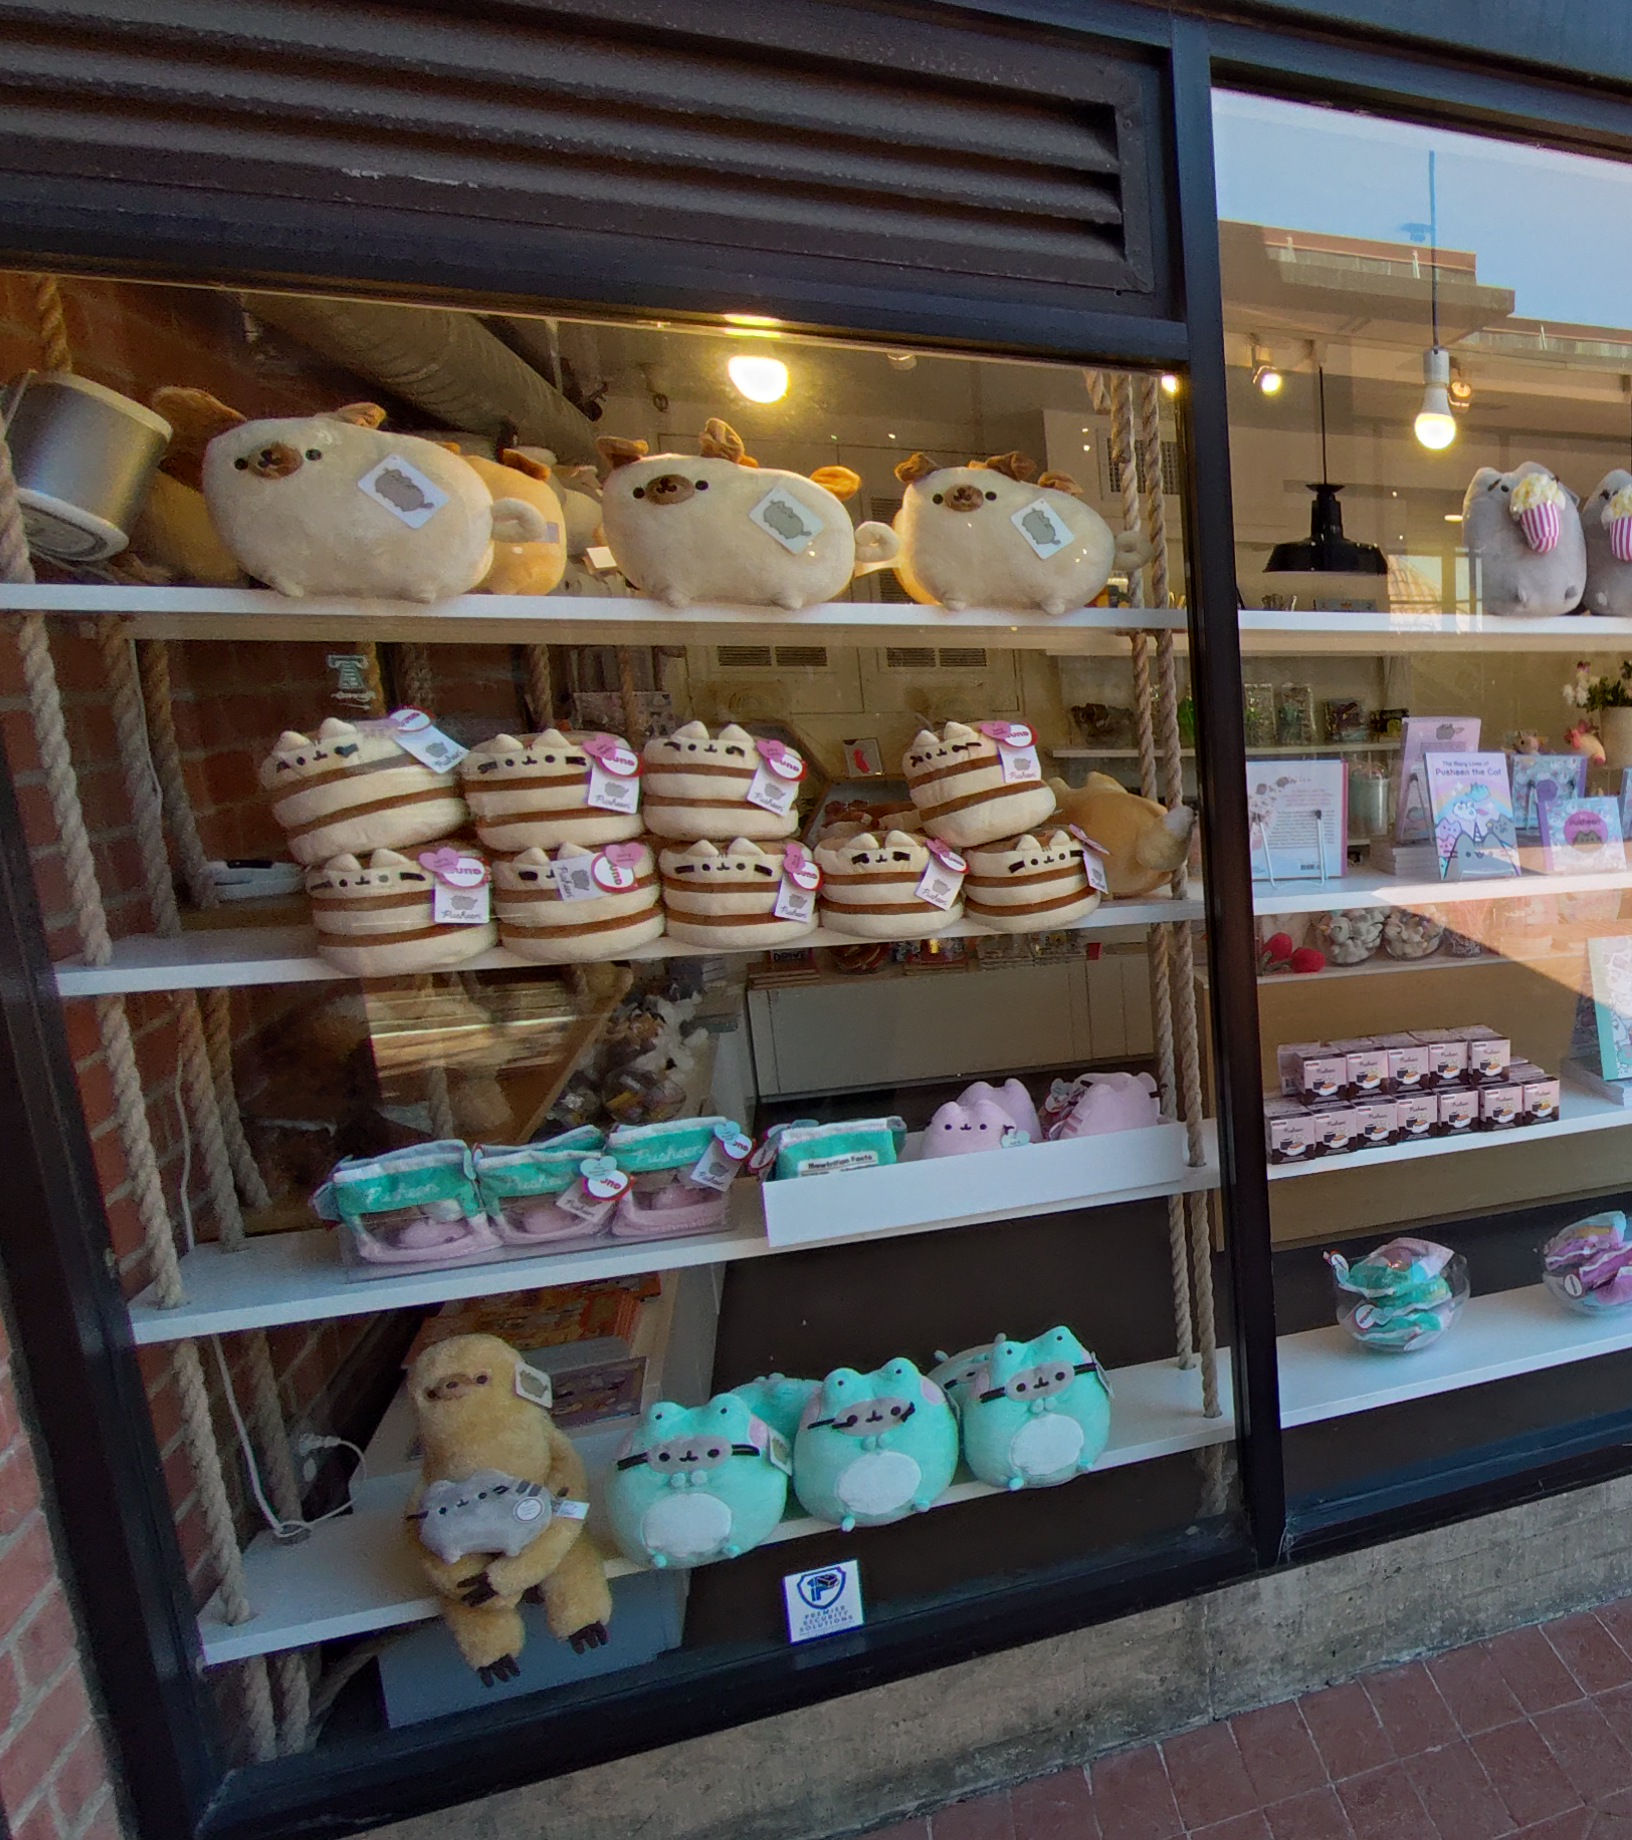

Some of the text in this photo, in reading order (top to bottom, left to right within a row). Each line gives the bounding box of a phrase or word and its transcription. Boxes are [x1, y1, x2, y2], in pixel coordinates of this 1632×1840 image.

[1435, 768, 1502, 777] Pusheen the Cat
[803, 1610, 848, 1627] SECURITY
[805, 1605, 845, 1620] PREMIER
[799, 1615, 854, 1633] SOLUTIONS
